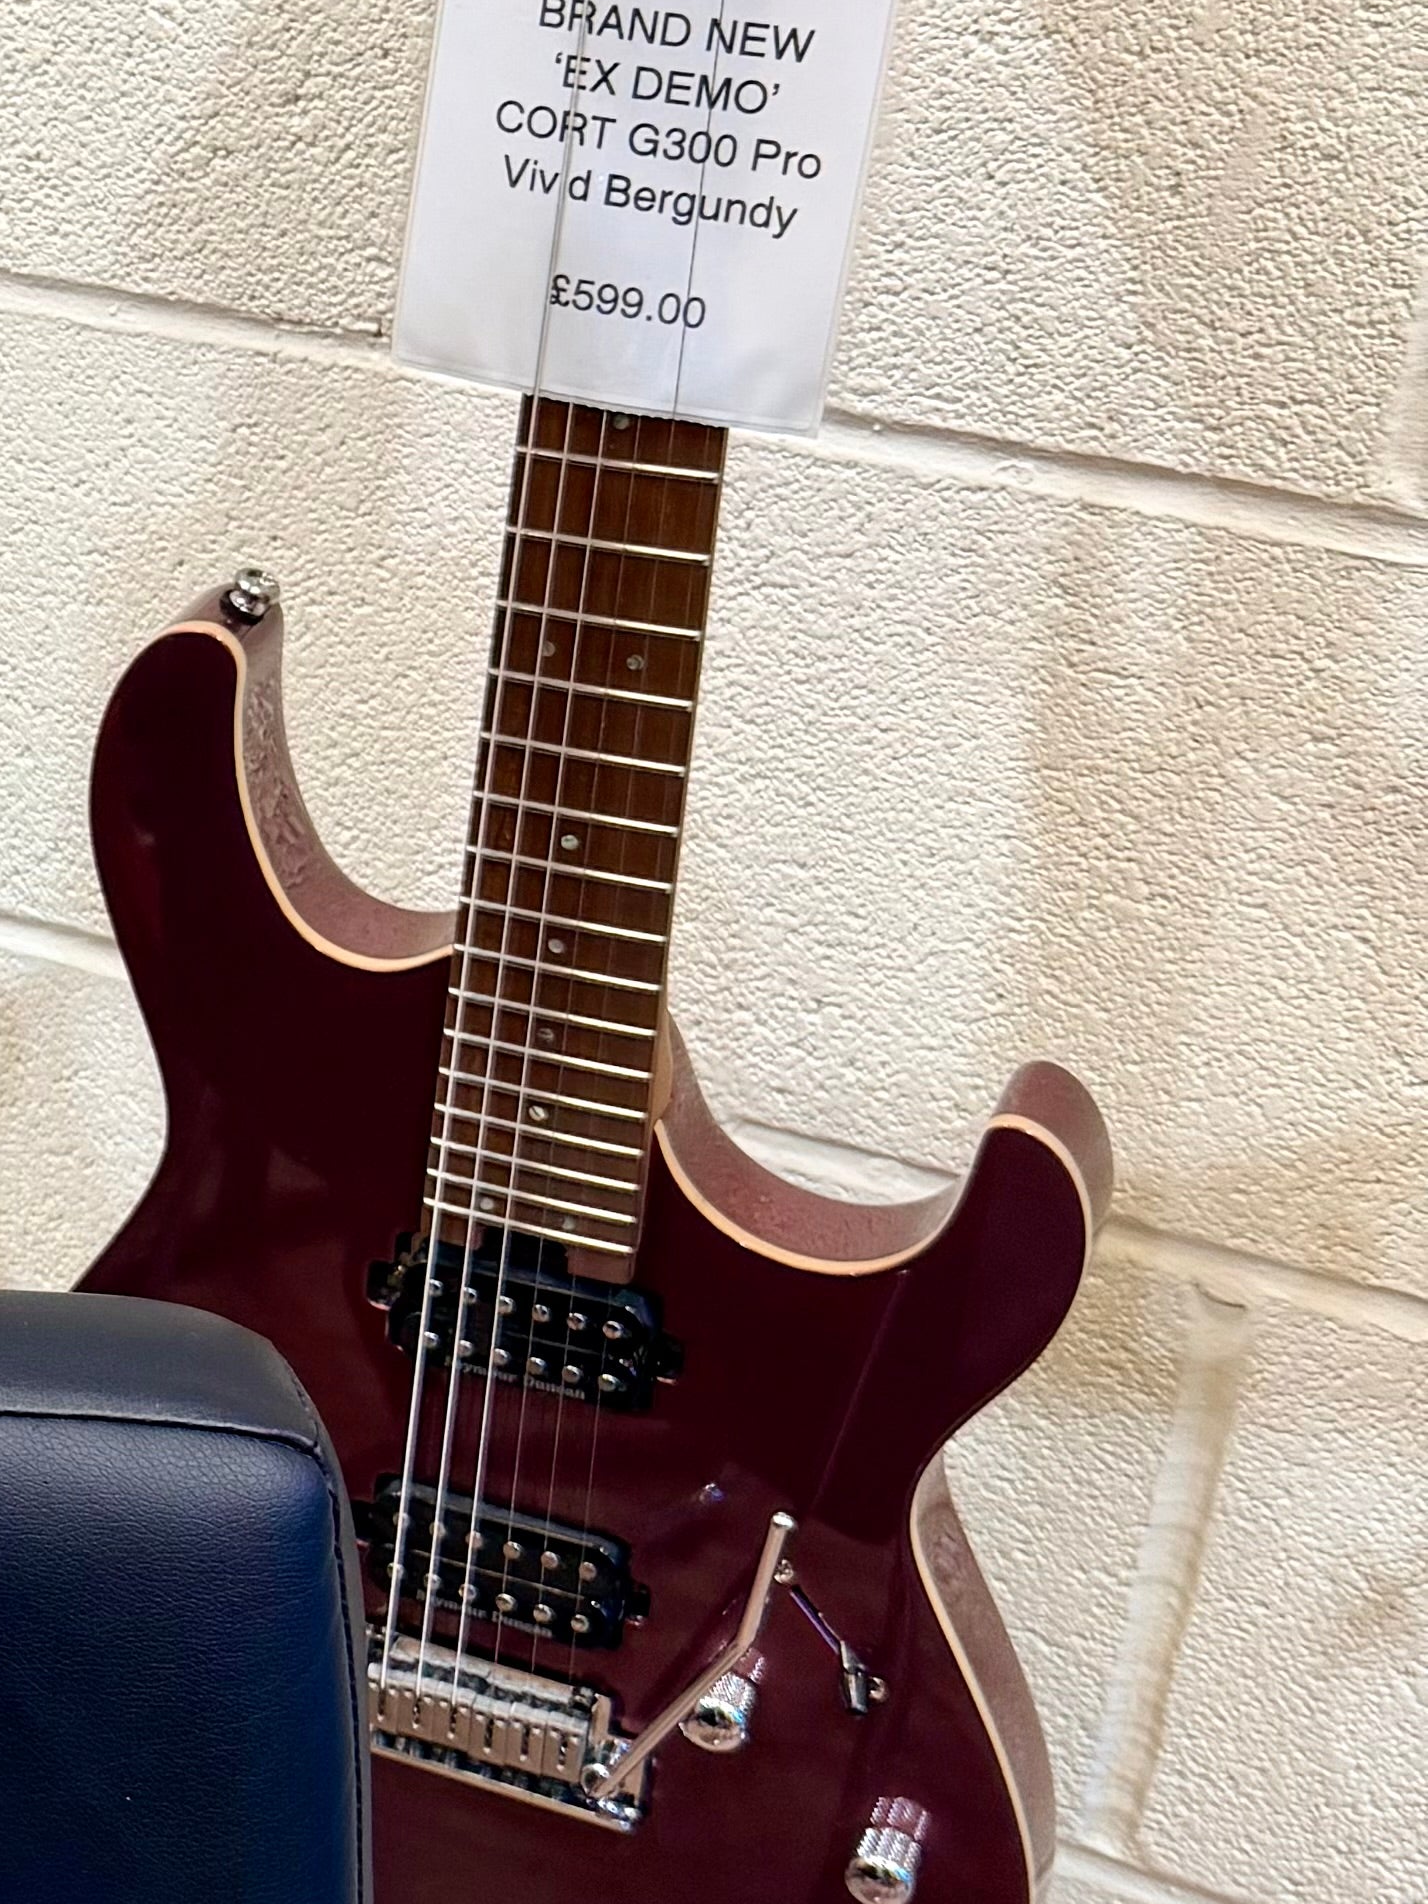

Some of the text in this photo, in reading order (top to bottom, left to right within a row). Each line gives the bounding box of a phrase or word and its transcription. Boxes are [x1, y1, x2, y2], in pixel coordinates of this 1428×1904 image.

[706, 18, 816, 64] NEW
[496, 99, 823, 181] CORT G300 Pro
[503, 154, 799, 239] Vivd Bergundy
[549, 273, 708, 330] £599.00
